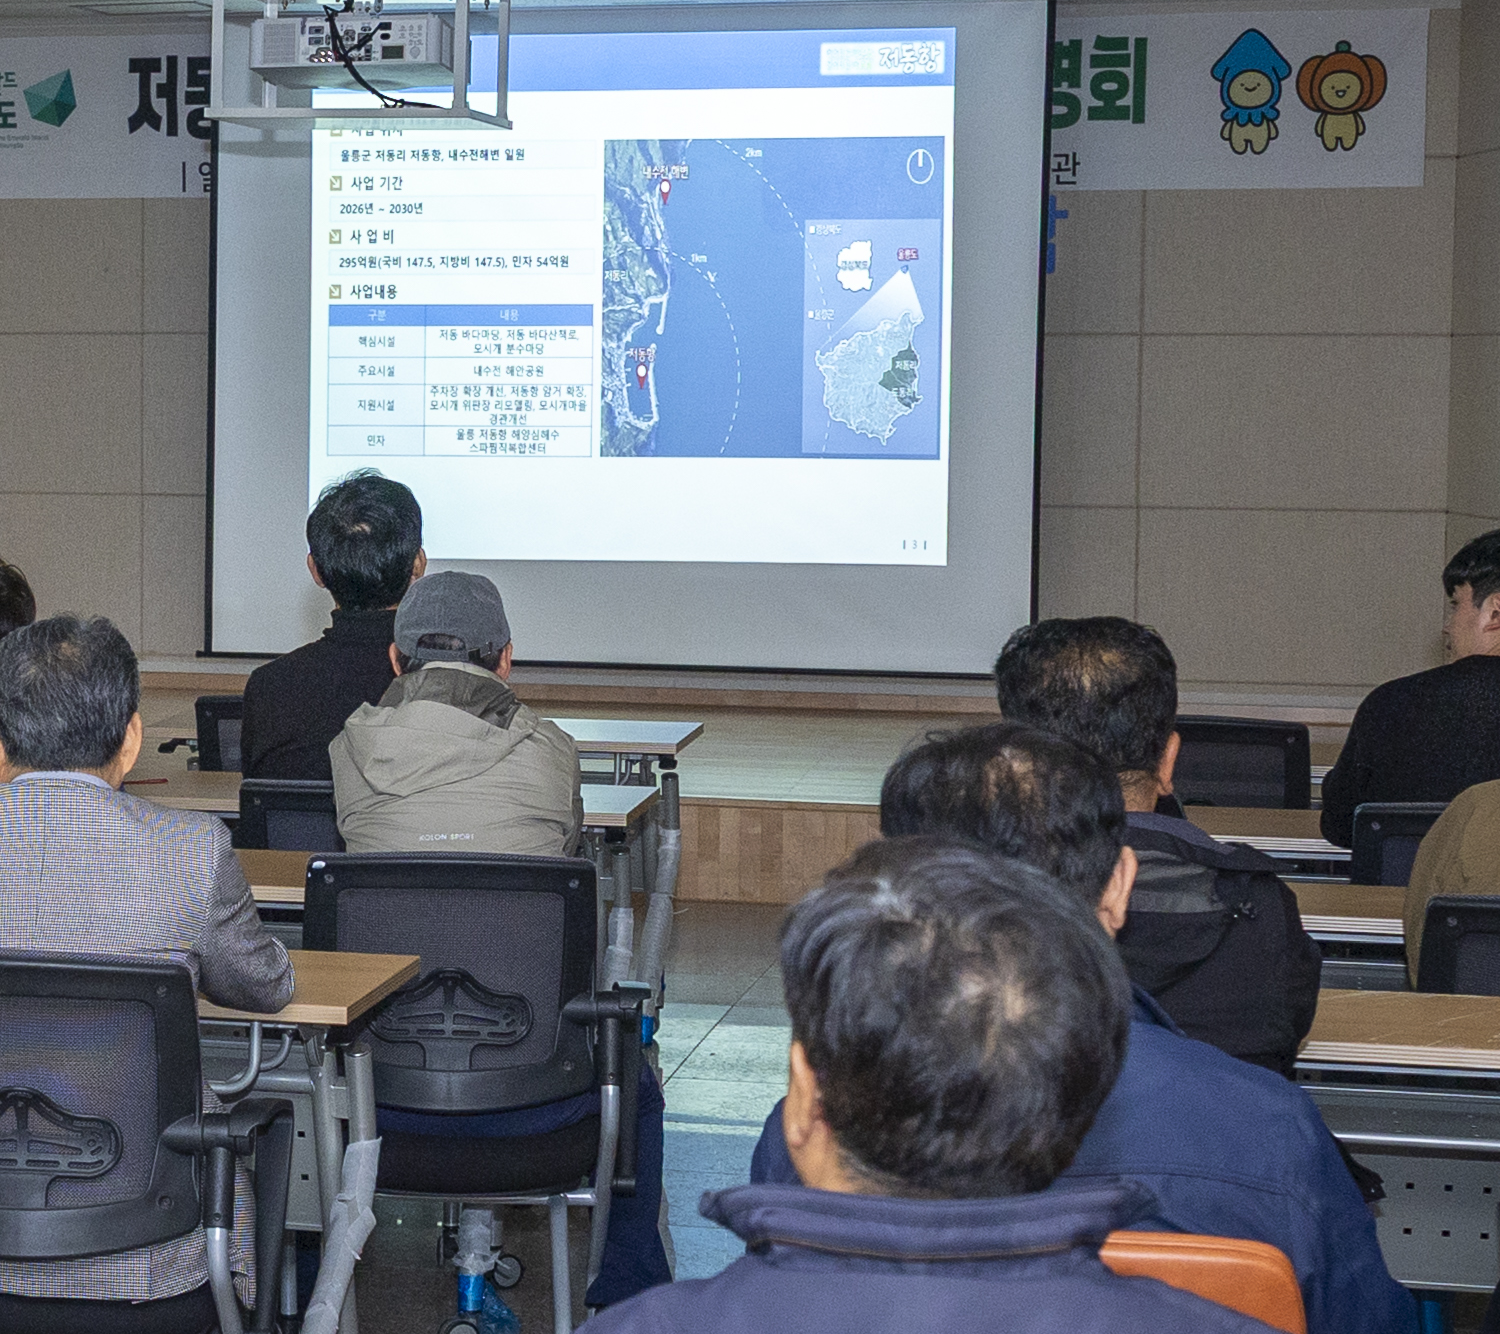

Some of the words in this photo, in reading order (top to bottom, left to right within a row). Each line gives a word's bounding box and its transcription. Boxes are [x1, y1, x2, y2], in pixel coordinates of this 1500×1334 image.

[879, 42, 940, 74] 저동항
[341, 149, 372, 163] 울릉군
[375, 149, 406, 163] 저동리
[448, 148, 500, 162] 내수전해변
[504, 148, 525, 161] 일원
[745, 148, 763, 158] 2km
[351, 176, 374, 191] 사업
[379, 176, 403, 191] 기간
[340, 203, 374, 215] 2026년
[389, 202, 423, 215] 2030년
[339, 256, 402, 270] 295억원(국비
[440, 256, 470, 269] 지방비
[512, 256, 533, 268] 민자
[536, 255, 569, 268] 54억원
[350, 284, 398, 300] 사업내용
[368, 309, 387, 321] 구분
[500, 309, 519, 321] 내용
[439, 329, 458, 340] 저동
[506, 329, 525, 340] 저동
[358, 336, 395, 347] 핵심시설
[506, 343, 544, 355] 분수마당
[358, 365, 395, 377] 주요시설
[474, 365, 501, 376] 내수전
[506, 365, 544, 377] 해안공원
[430, 385, 458, 397] 주차장
[510, 386, 538, 397] 저동항
[357, 399, 395, 411] 지원시설
